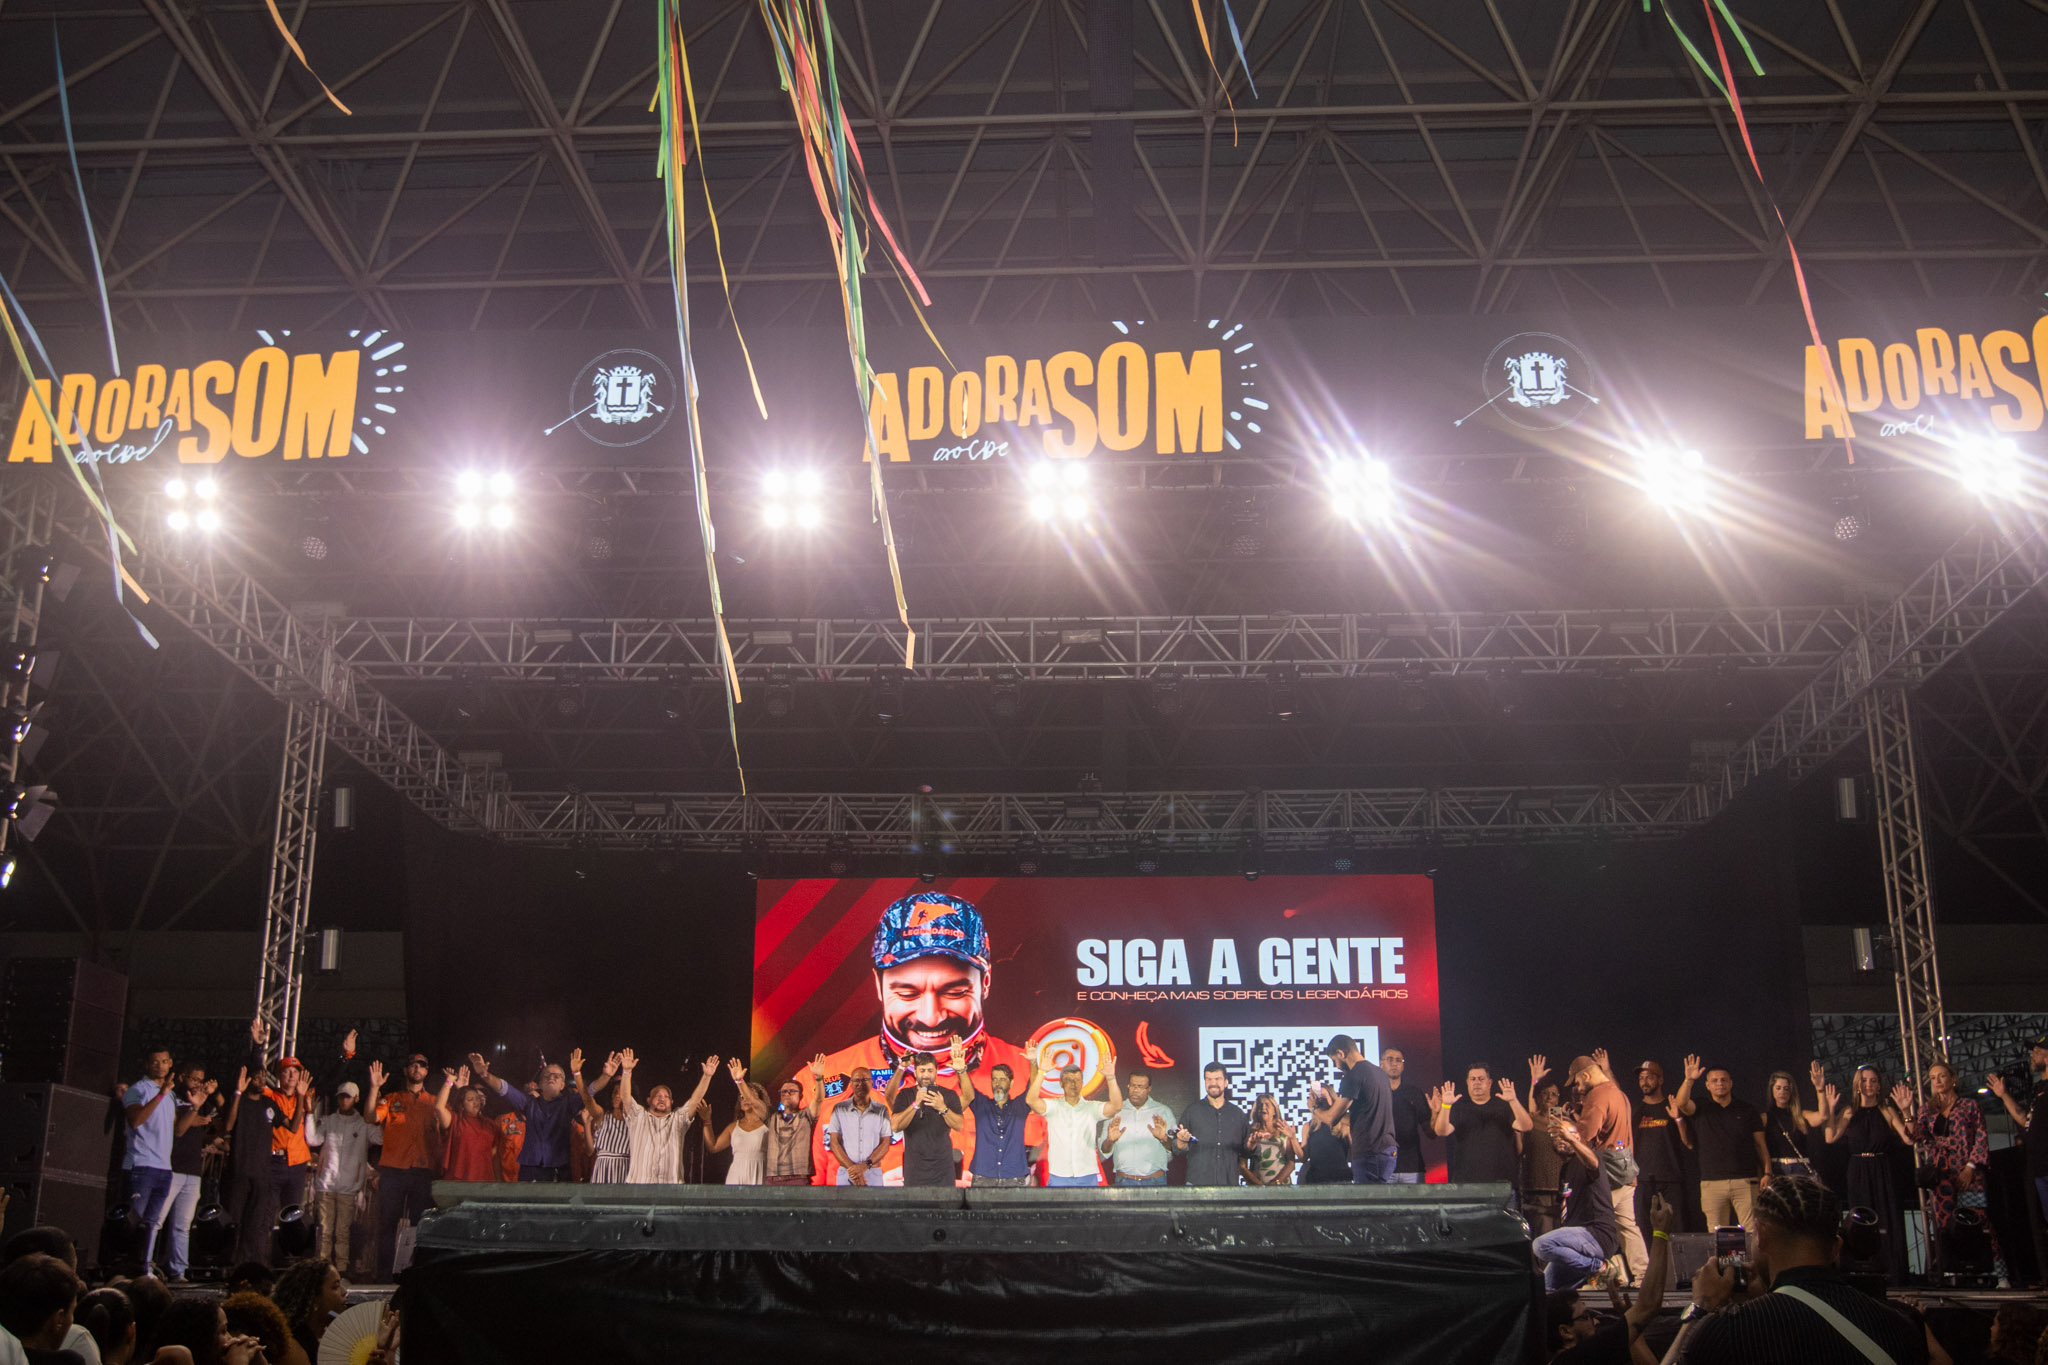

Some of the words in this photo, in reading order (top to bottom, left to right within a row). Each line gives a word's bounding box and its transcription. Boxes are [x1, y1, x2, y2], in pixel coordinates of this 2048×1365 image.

[7, 346, 360, 463] ADORASOM
[862, 341, 1223, 462] ADORASOM
[1805, 314, 2048, 439] ADORAS
[1077, 938, 1192, 986] SIGA
[1208, 938, 1242, 985] A
[1258, 937, 1406, 985] GENTE
[1077, 991, 1087, 1000] E
[1090, 991, 1169, 1002] CONHEÇA
[1170, 991, 1210, 1000] MAIS
[1213, 990, 1267, 1000] SOBRE
[1270, 990, 1293, 1000] OS
[1296, 986, 1409, 999] LEGENDÁRIOS
